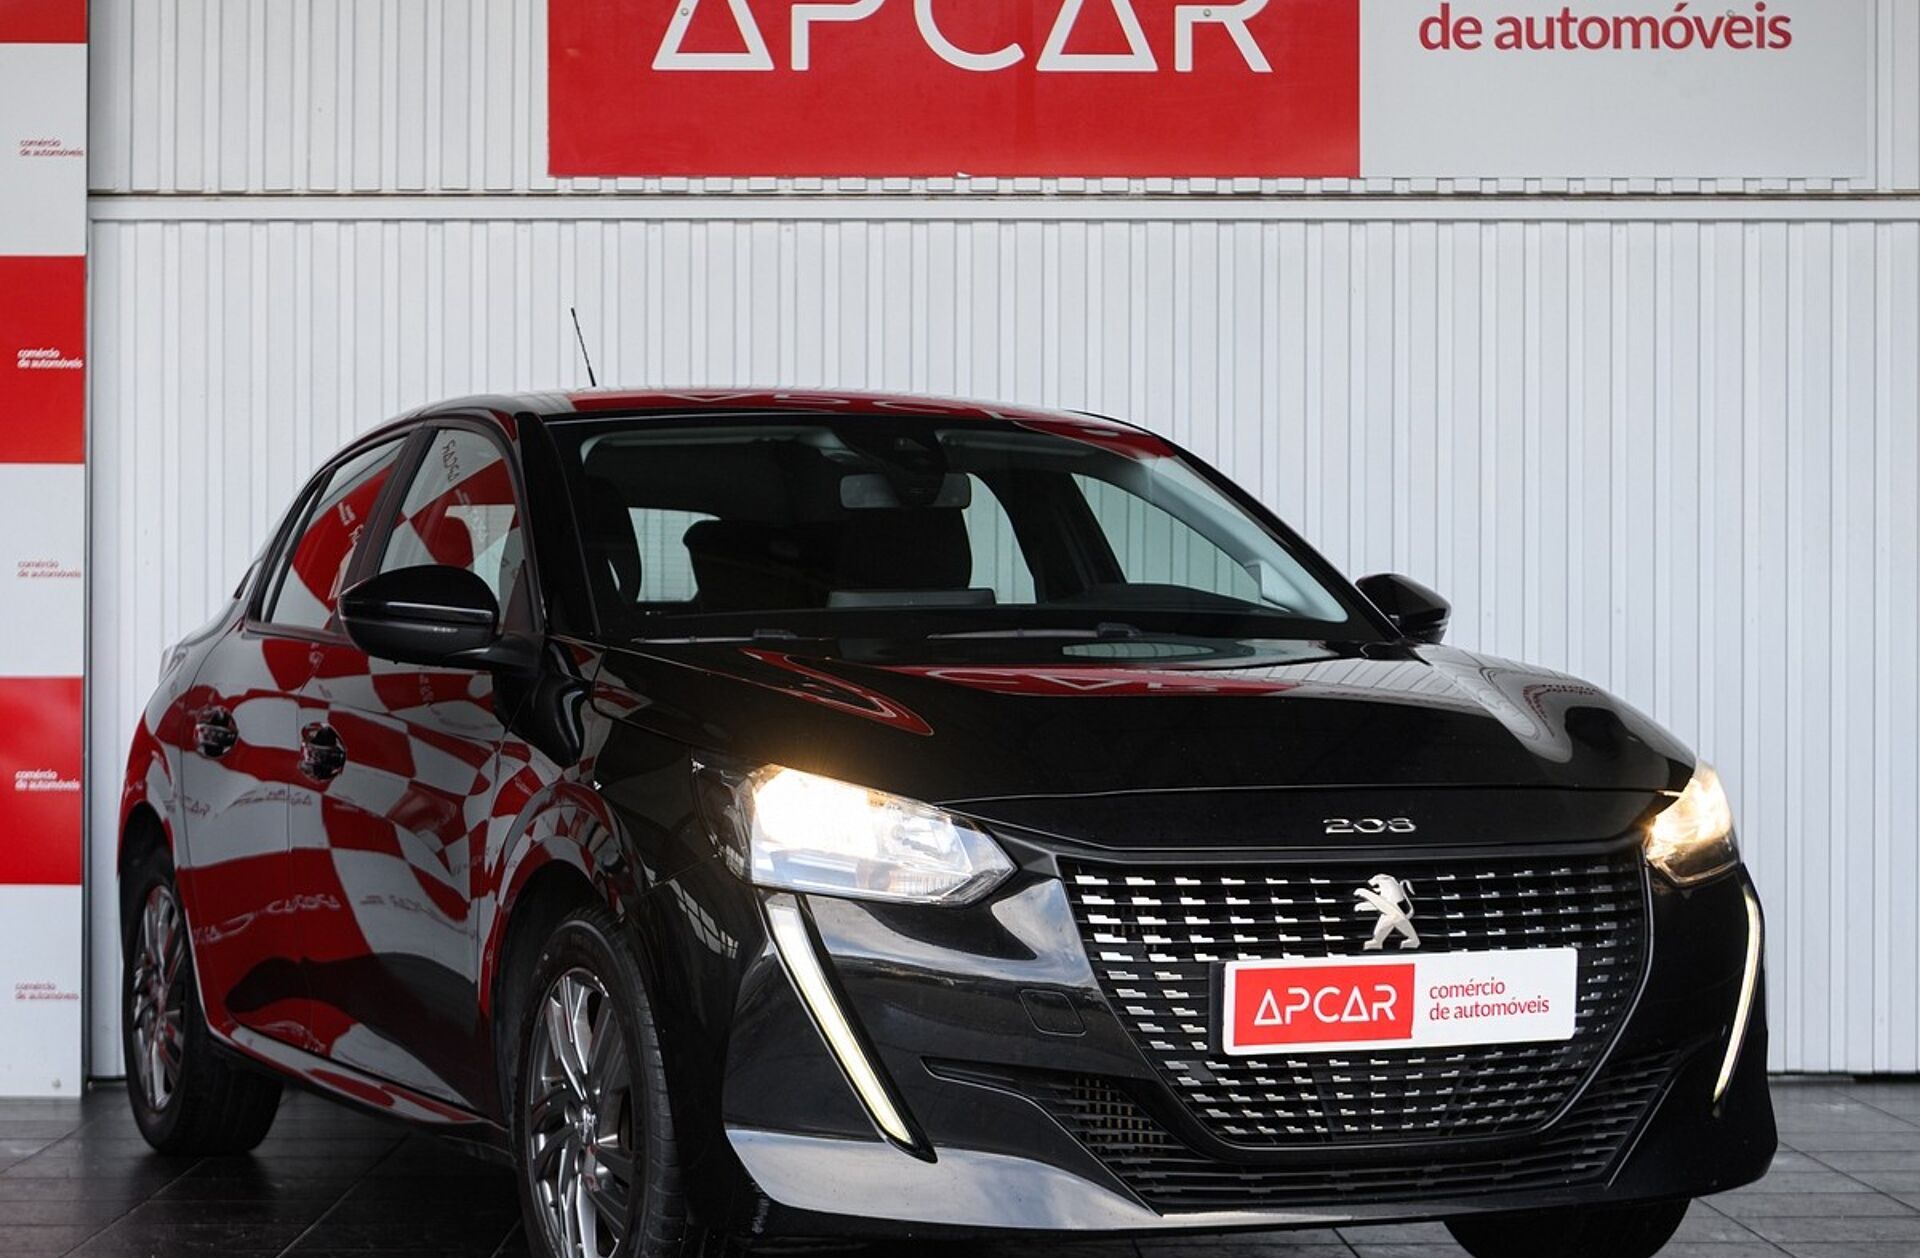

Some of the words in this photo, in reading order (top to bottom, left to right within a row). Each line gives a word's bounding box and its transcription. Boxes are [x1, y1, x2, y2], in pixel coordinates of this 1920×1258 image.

[1418, 2, 1482, 50] de
[1494, 1, 1792, 50] automóveis
[1322, 817, 1416, 834] 208
[1429, 976, 1506, 1000] comércio
[1253, 983, 1398, 1027] APCAR
[1429, 1002, 1450, 1021] de
[1453, 994, 1550, 1019] automóveis
